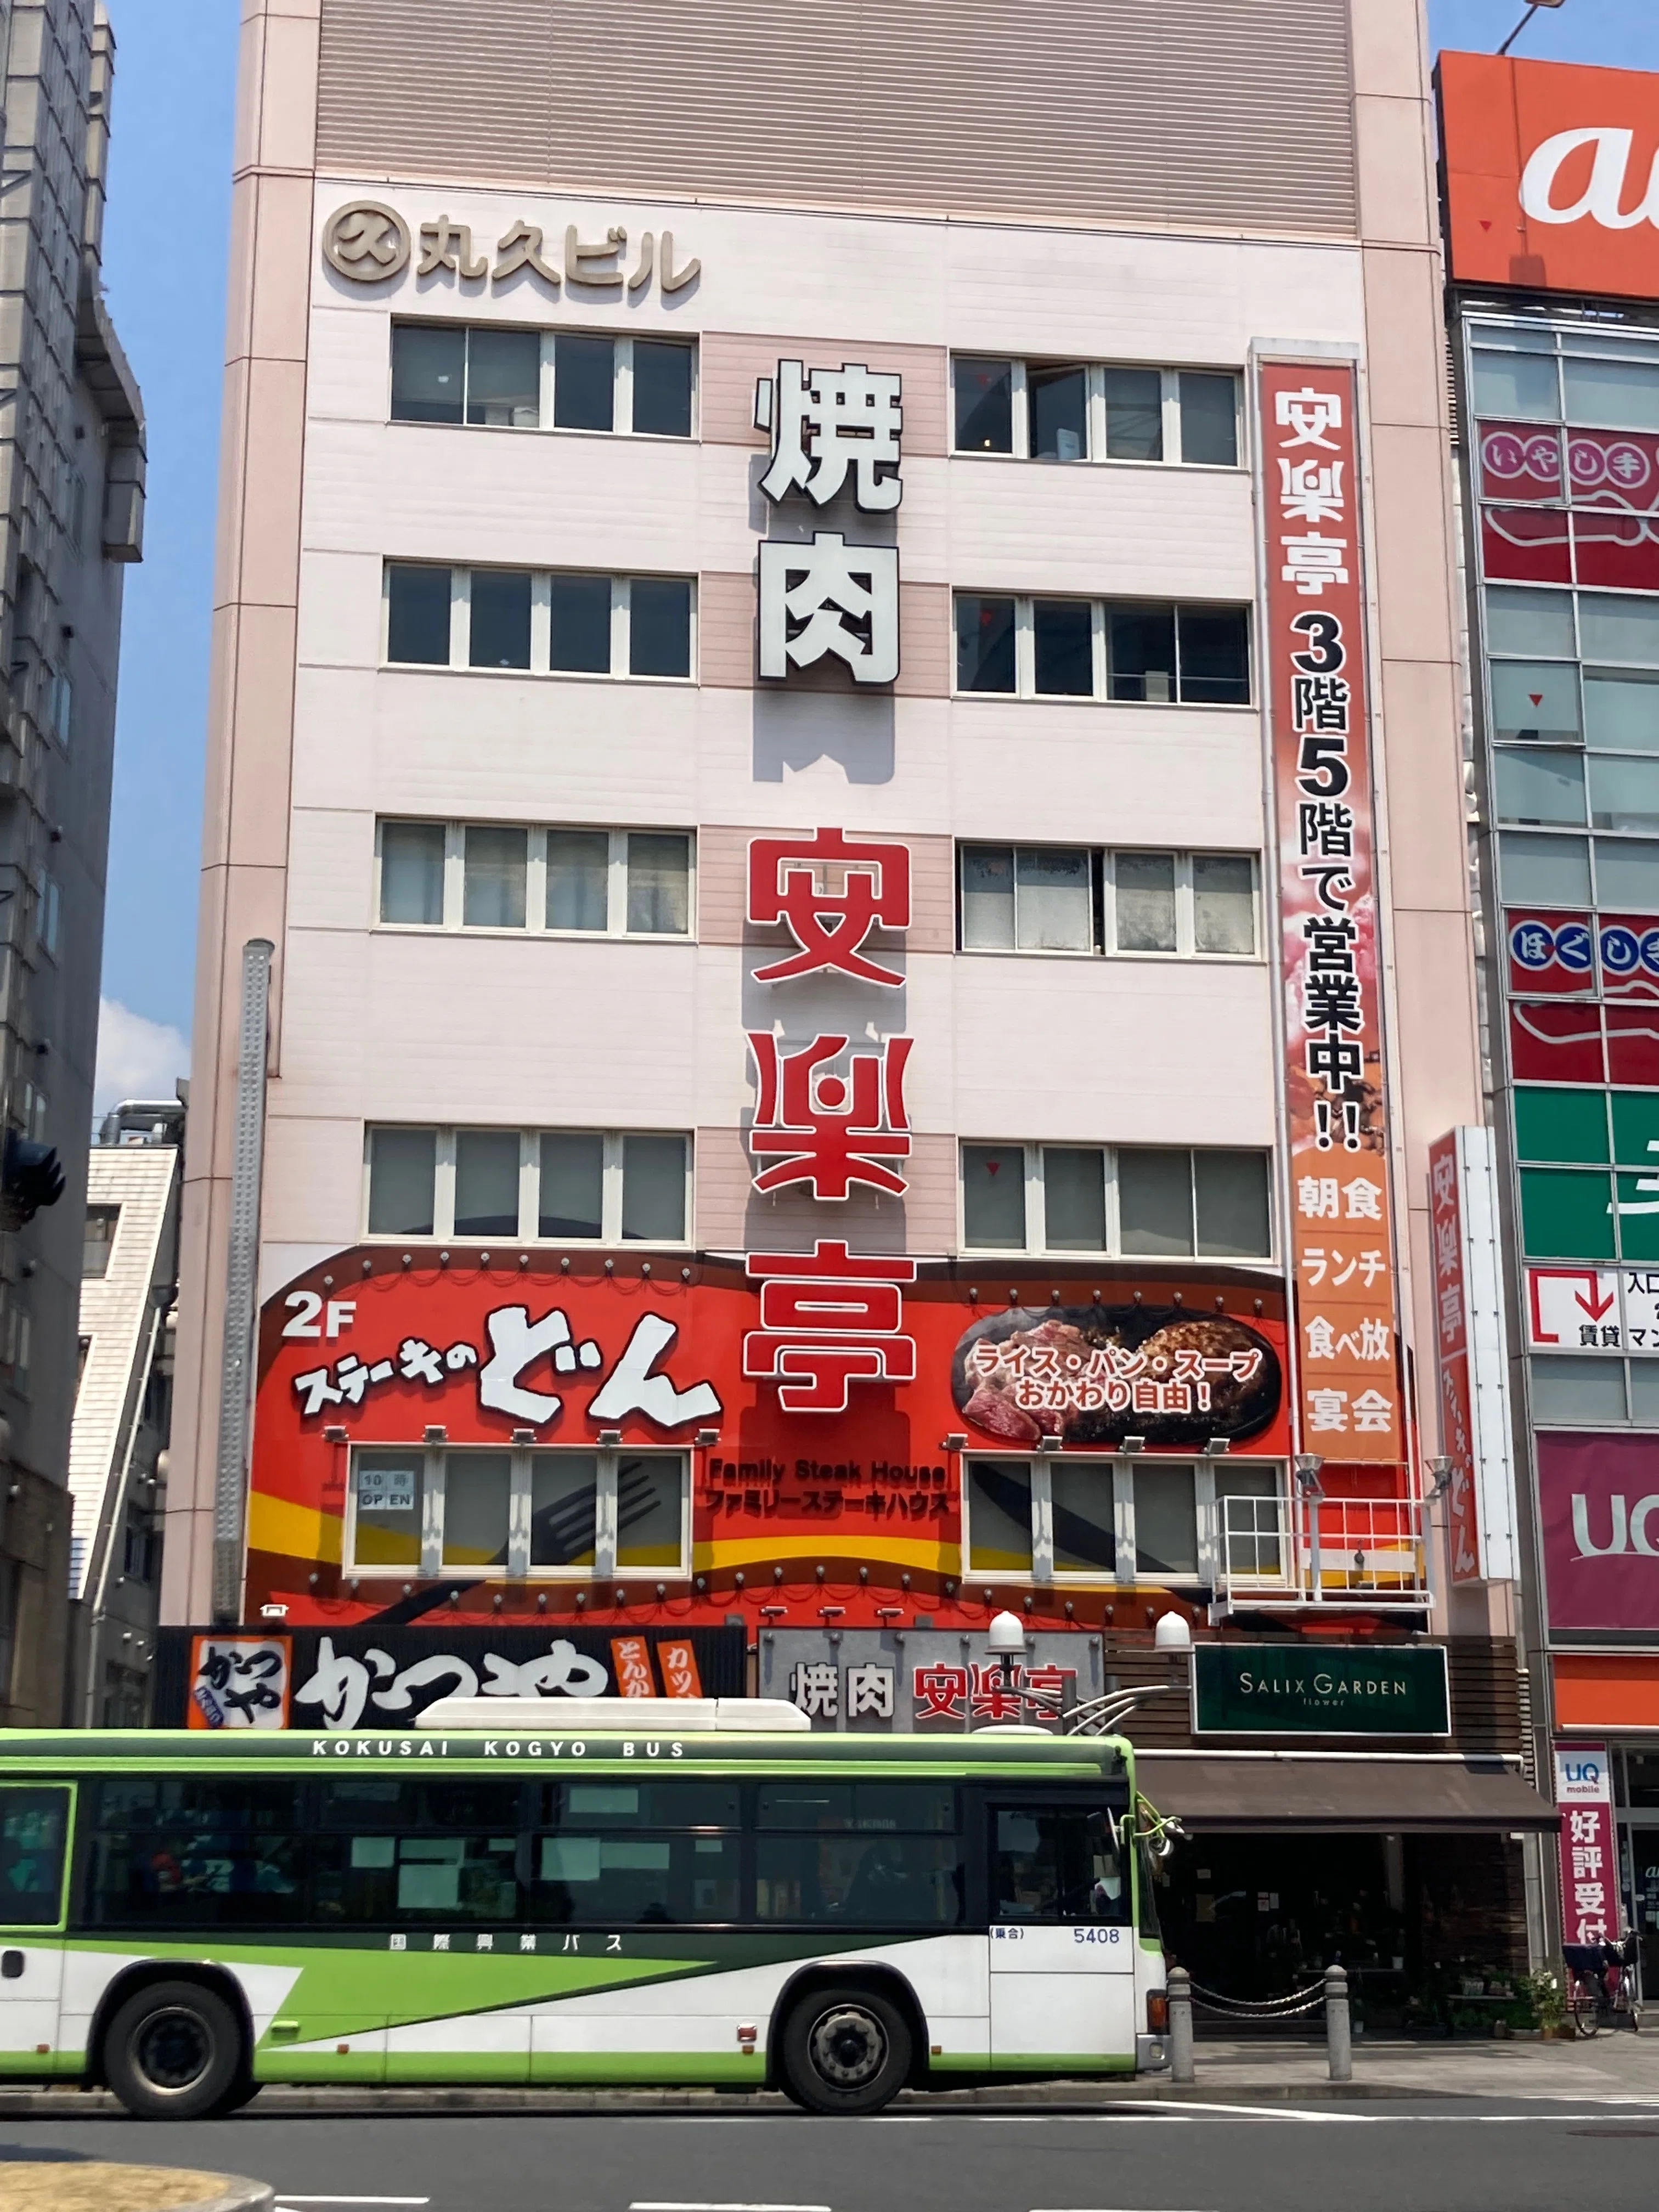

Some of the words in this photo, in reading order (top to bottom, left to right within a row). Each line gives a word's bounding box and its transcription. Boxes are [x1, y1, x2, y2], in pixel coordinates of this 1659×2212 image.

[1519, 127, 1659, 229] a
[417, 214, 702, 293] 丸久ビル
[753, 359, 903, 684] 焼肉
[744, 827, 917, 1412] 安楽亭
[1297, 1176, 1383, 1220] 朝食
[1301, 1247, 1386, 1287] ランチ
[1433, 1154, 1466, 1344] 安楽亭
[281, 1290, 357, 1338] 2F
[1305, 1316, 1390, 1361] 食べ放
[1307, 1389, 1393, 1433] 宴会
[709, 1458, 785, 1482] Family
[794, 1459, 861, 1481] Steak
[871, 1460, 946, 1483] House
[362, 1494, 410, 1505] OPEN
[705, 1488, 950, 1519] ファミリーステーキハウス
[294, 1637, 608, 1729] かつや
[661, 1647, 698, 1698] カツ
[790, 1662, 895, 1718] 焼肉
[313, 1740, 448, 1756] KOKUSAI
[484, 1741, 586, 1756] KOGYO
[623, 1741, 684, 1757] BUS
[1565, 1762, 1599, 1785] UQ
[1566, 1785, 1600, 1793] mobile
[1074, 1928, 1120, 1943] 5408
